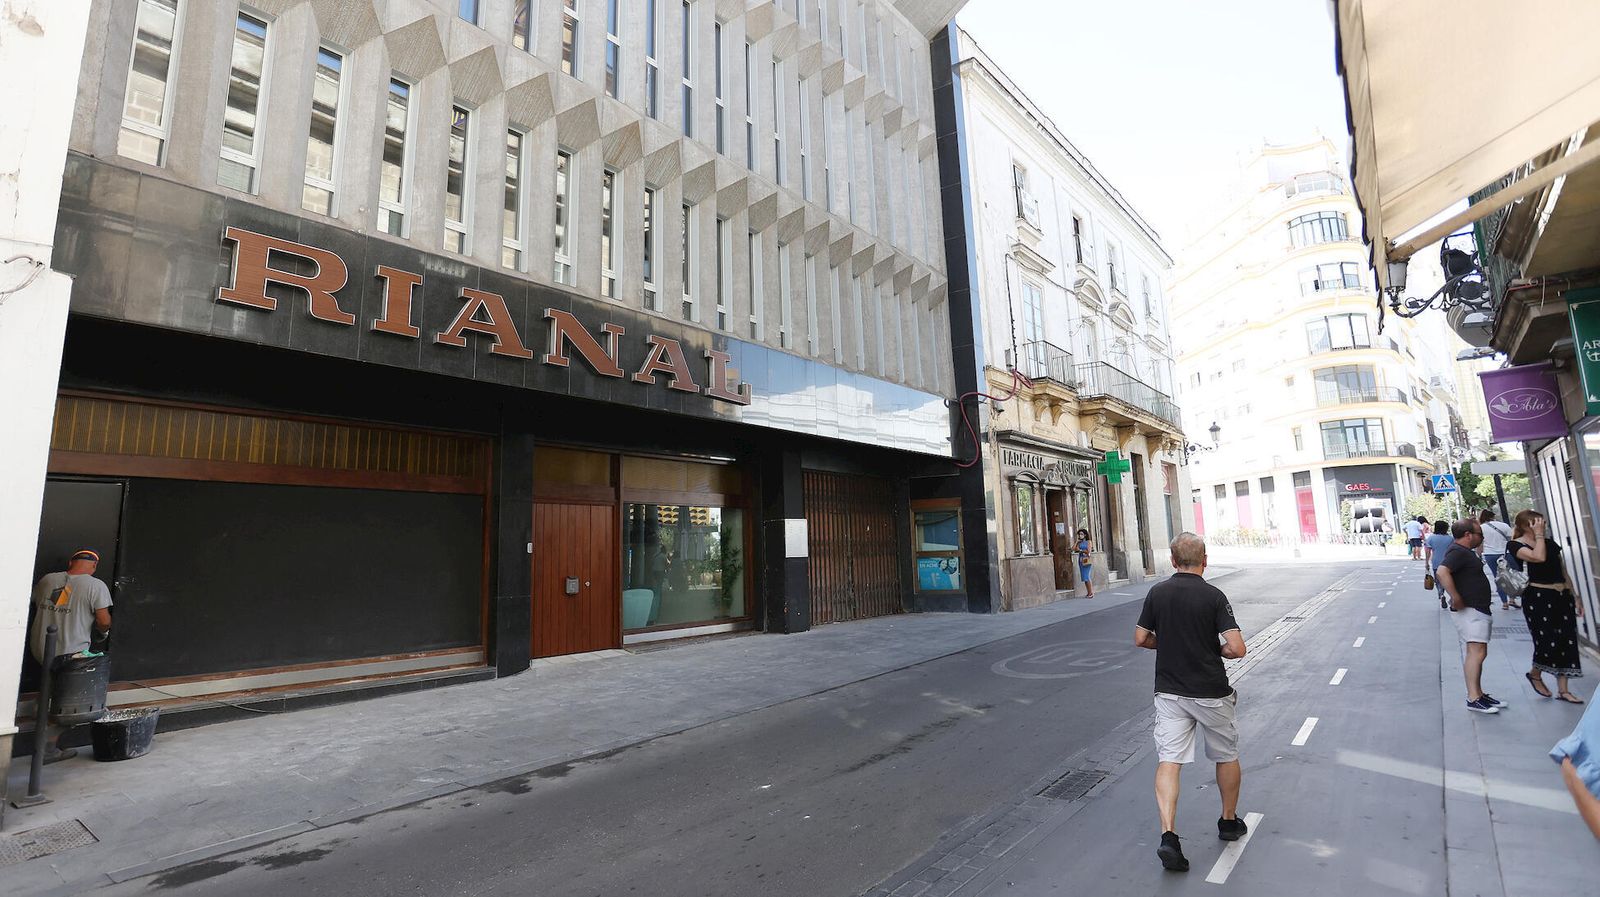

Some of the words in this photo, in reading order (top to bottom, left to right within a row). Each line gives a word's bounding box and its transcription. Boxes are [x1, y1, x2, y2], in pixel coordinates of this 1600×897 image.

[218, 226, 752, 406] RIANAL
[1003, 449, 1045, 471] FARMACIA
[1345, 483, 1370, 491] GAES
